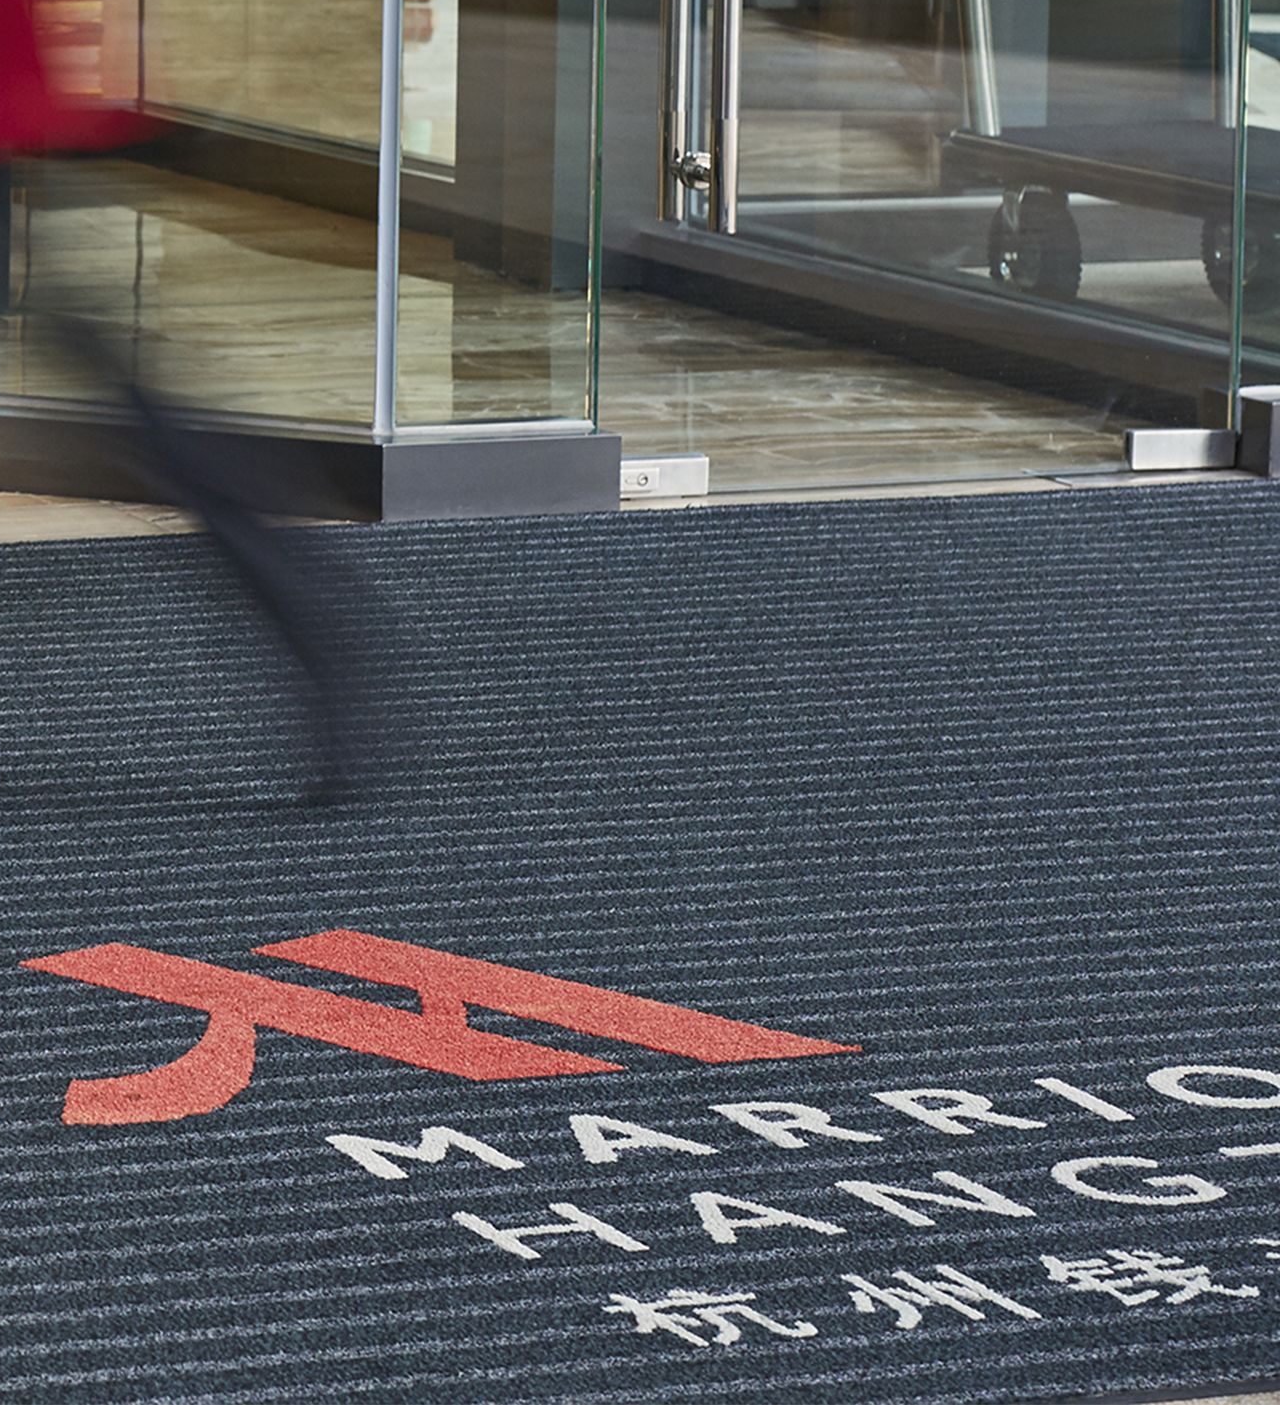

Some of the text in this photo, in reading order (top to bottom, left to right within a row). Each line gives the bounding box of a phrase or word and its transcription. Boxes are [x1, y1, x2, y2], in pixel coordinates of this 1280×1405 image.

[325, 1063, 1280, 1180] MARRIO
[601, 1236, 1280, 1347] 杭州钱
